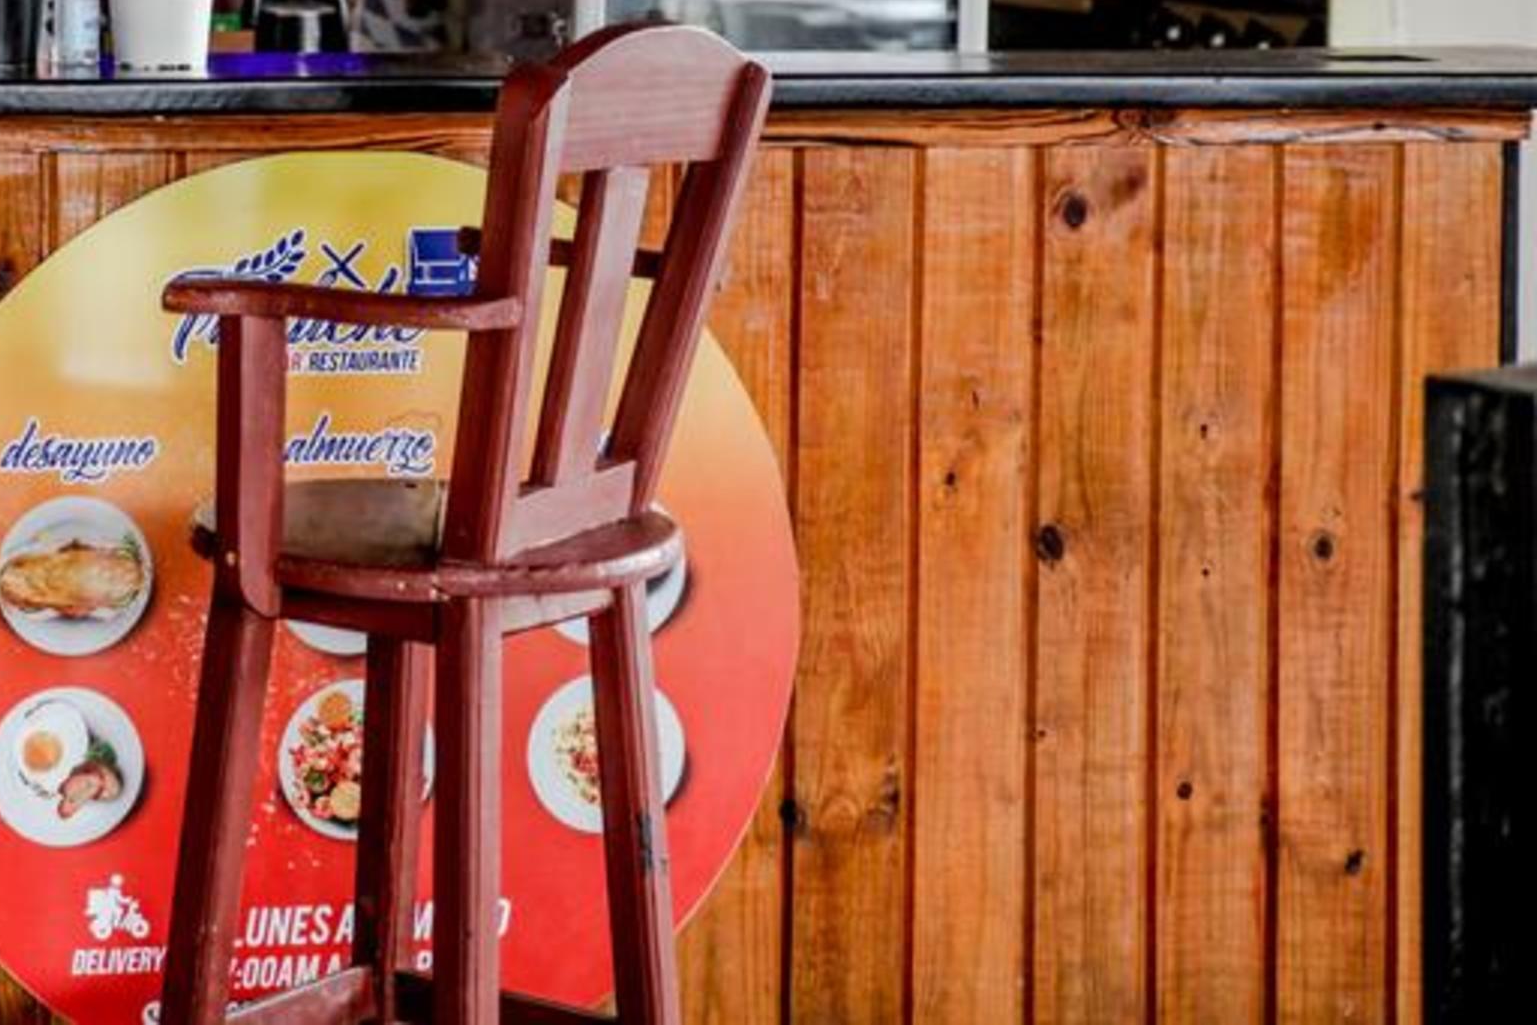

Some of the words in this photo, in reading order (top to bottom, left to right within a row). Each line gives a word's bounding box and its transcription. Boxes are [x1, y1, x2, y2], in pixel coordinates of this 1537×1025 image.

[308, 349, 421, 372] RESTAURANTE
[0, 421, 156, 479] desayuno
[284, 415, 434, 474] almuerzo
[233, 904, 332, 947] UNES
[71, 946, 166, 976] DELIVERY
